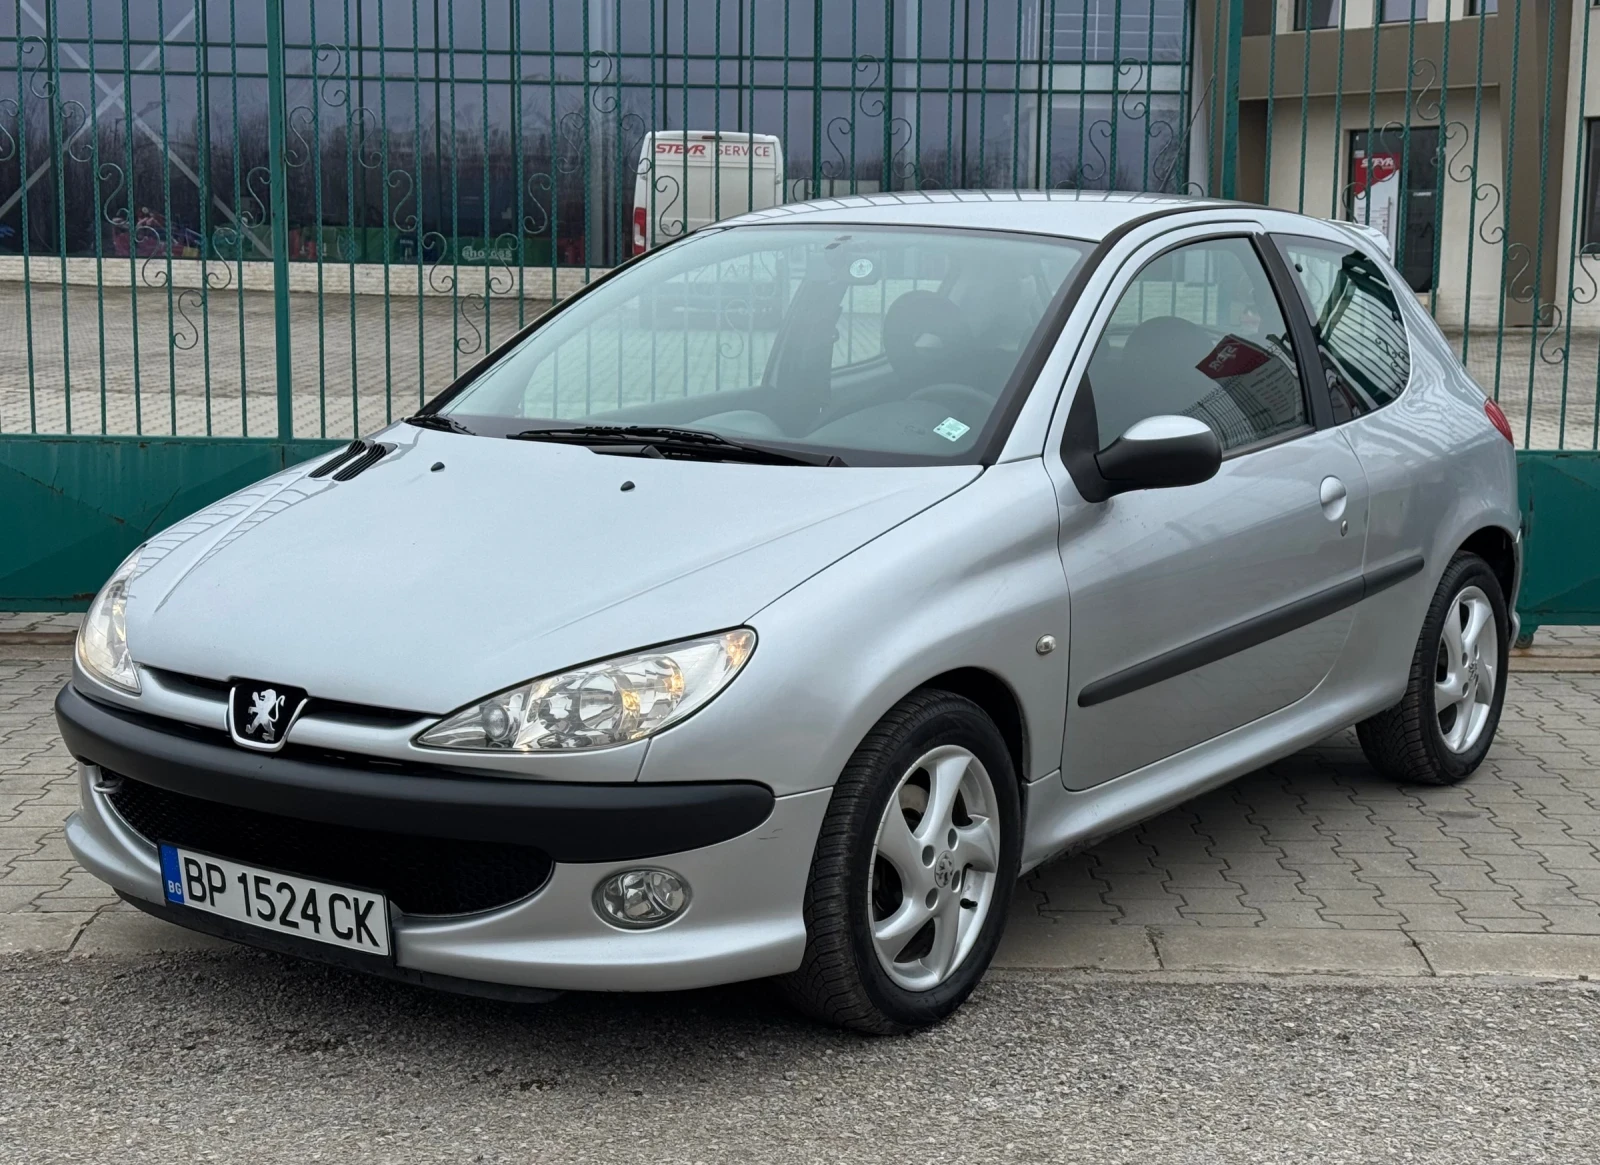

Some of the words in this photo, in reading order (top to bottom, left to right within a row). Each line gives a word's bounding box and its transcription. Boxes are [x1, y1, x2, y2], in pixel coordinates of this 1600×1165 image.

[716, 144, 770, 157] SERVCE
[168, 880, 182, 895] BG
[183, 856, 226, 907] BP
[237, 872, 321, 935] 1524
[328, 892, 381, 948] CK
